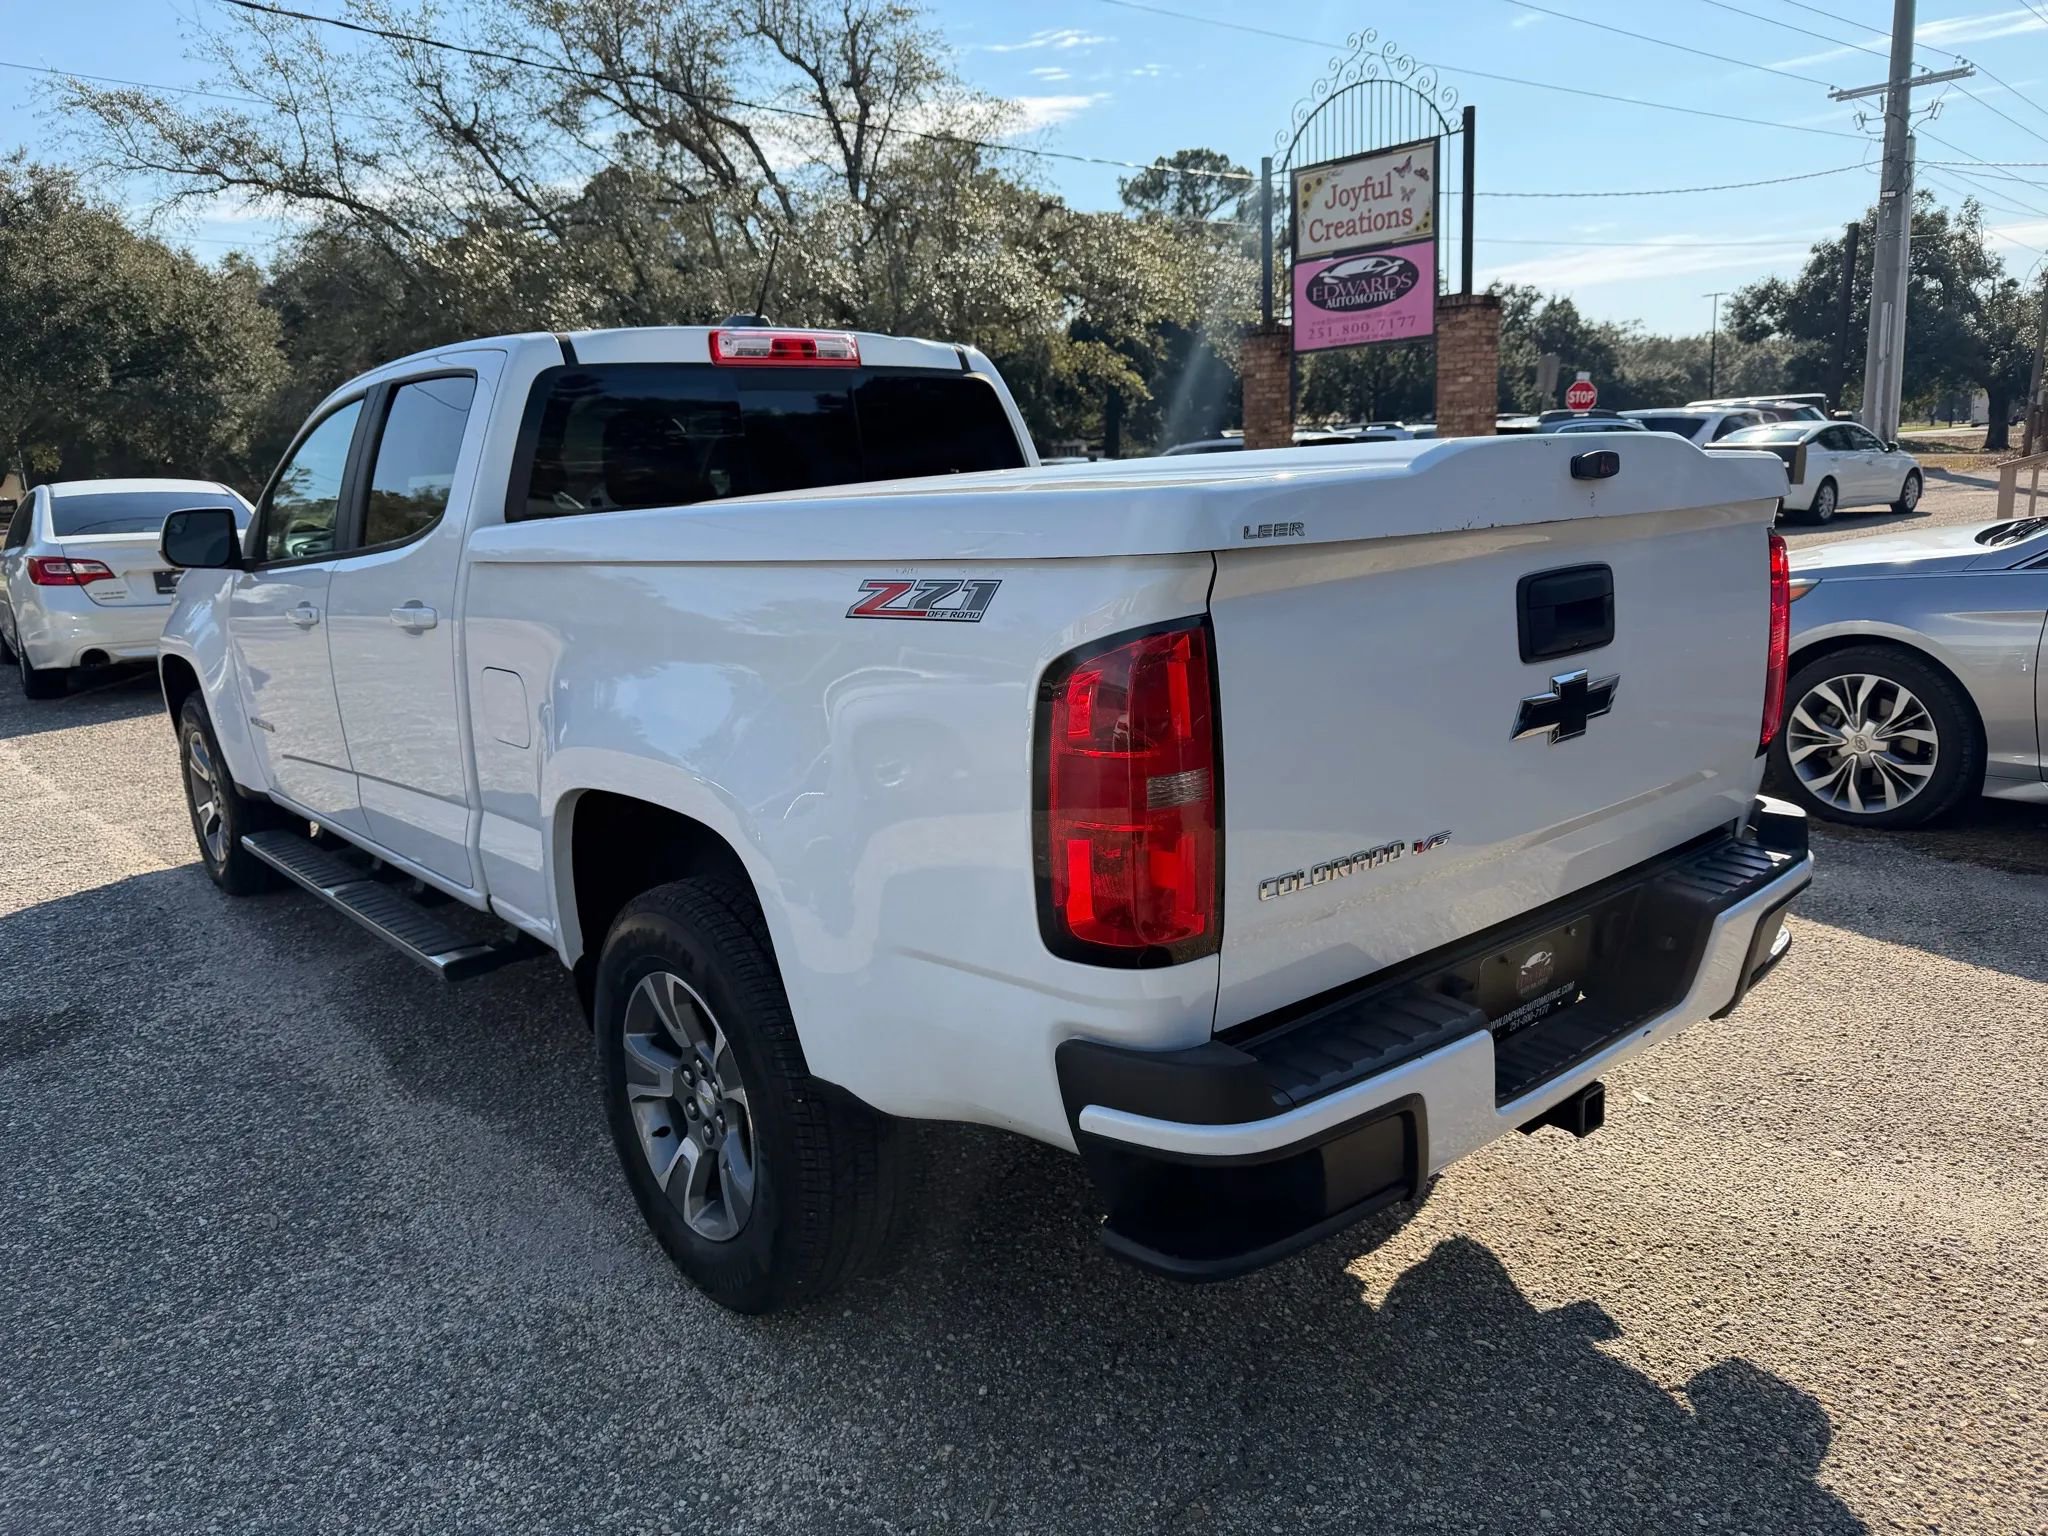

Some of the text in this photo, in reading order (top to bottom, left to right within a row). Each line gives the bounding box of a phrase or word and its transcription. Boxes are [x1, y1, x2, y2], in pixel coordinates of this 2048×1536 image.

[1324, 172, 1393, 212] Joyful
[1309, 208, 1413, 243] Creations
[1312, 272, 1413, 301] EDWARDS
[1325, 289, 1397, 309] AUTOMOTIVE
[1308, 315, 1416, 340] 251.800.7177
[1568, 391, 1595, 404] STOP
[1243, 521, 1306, 540] LEER
[846, 579, 1003, 622] Z71
[926, 610, 981, 619] OFF ROAD
[1259, 839, 1405, 901] COLORADO
